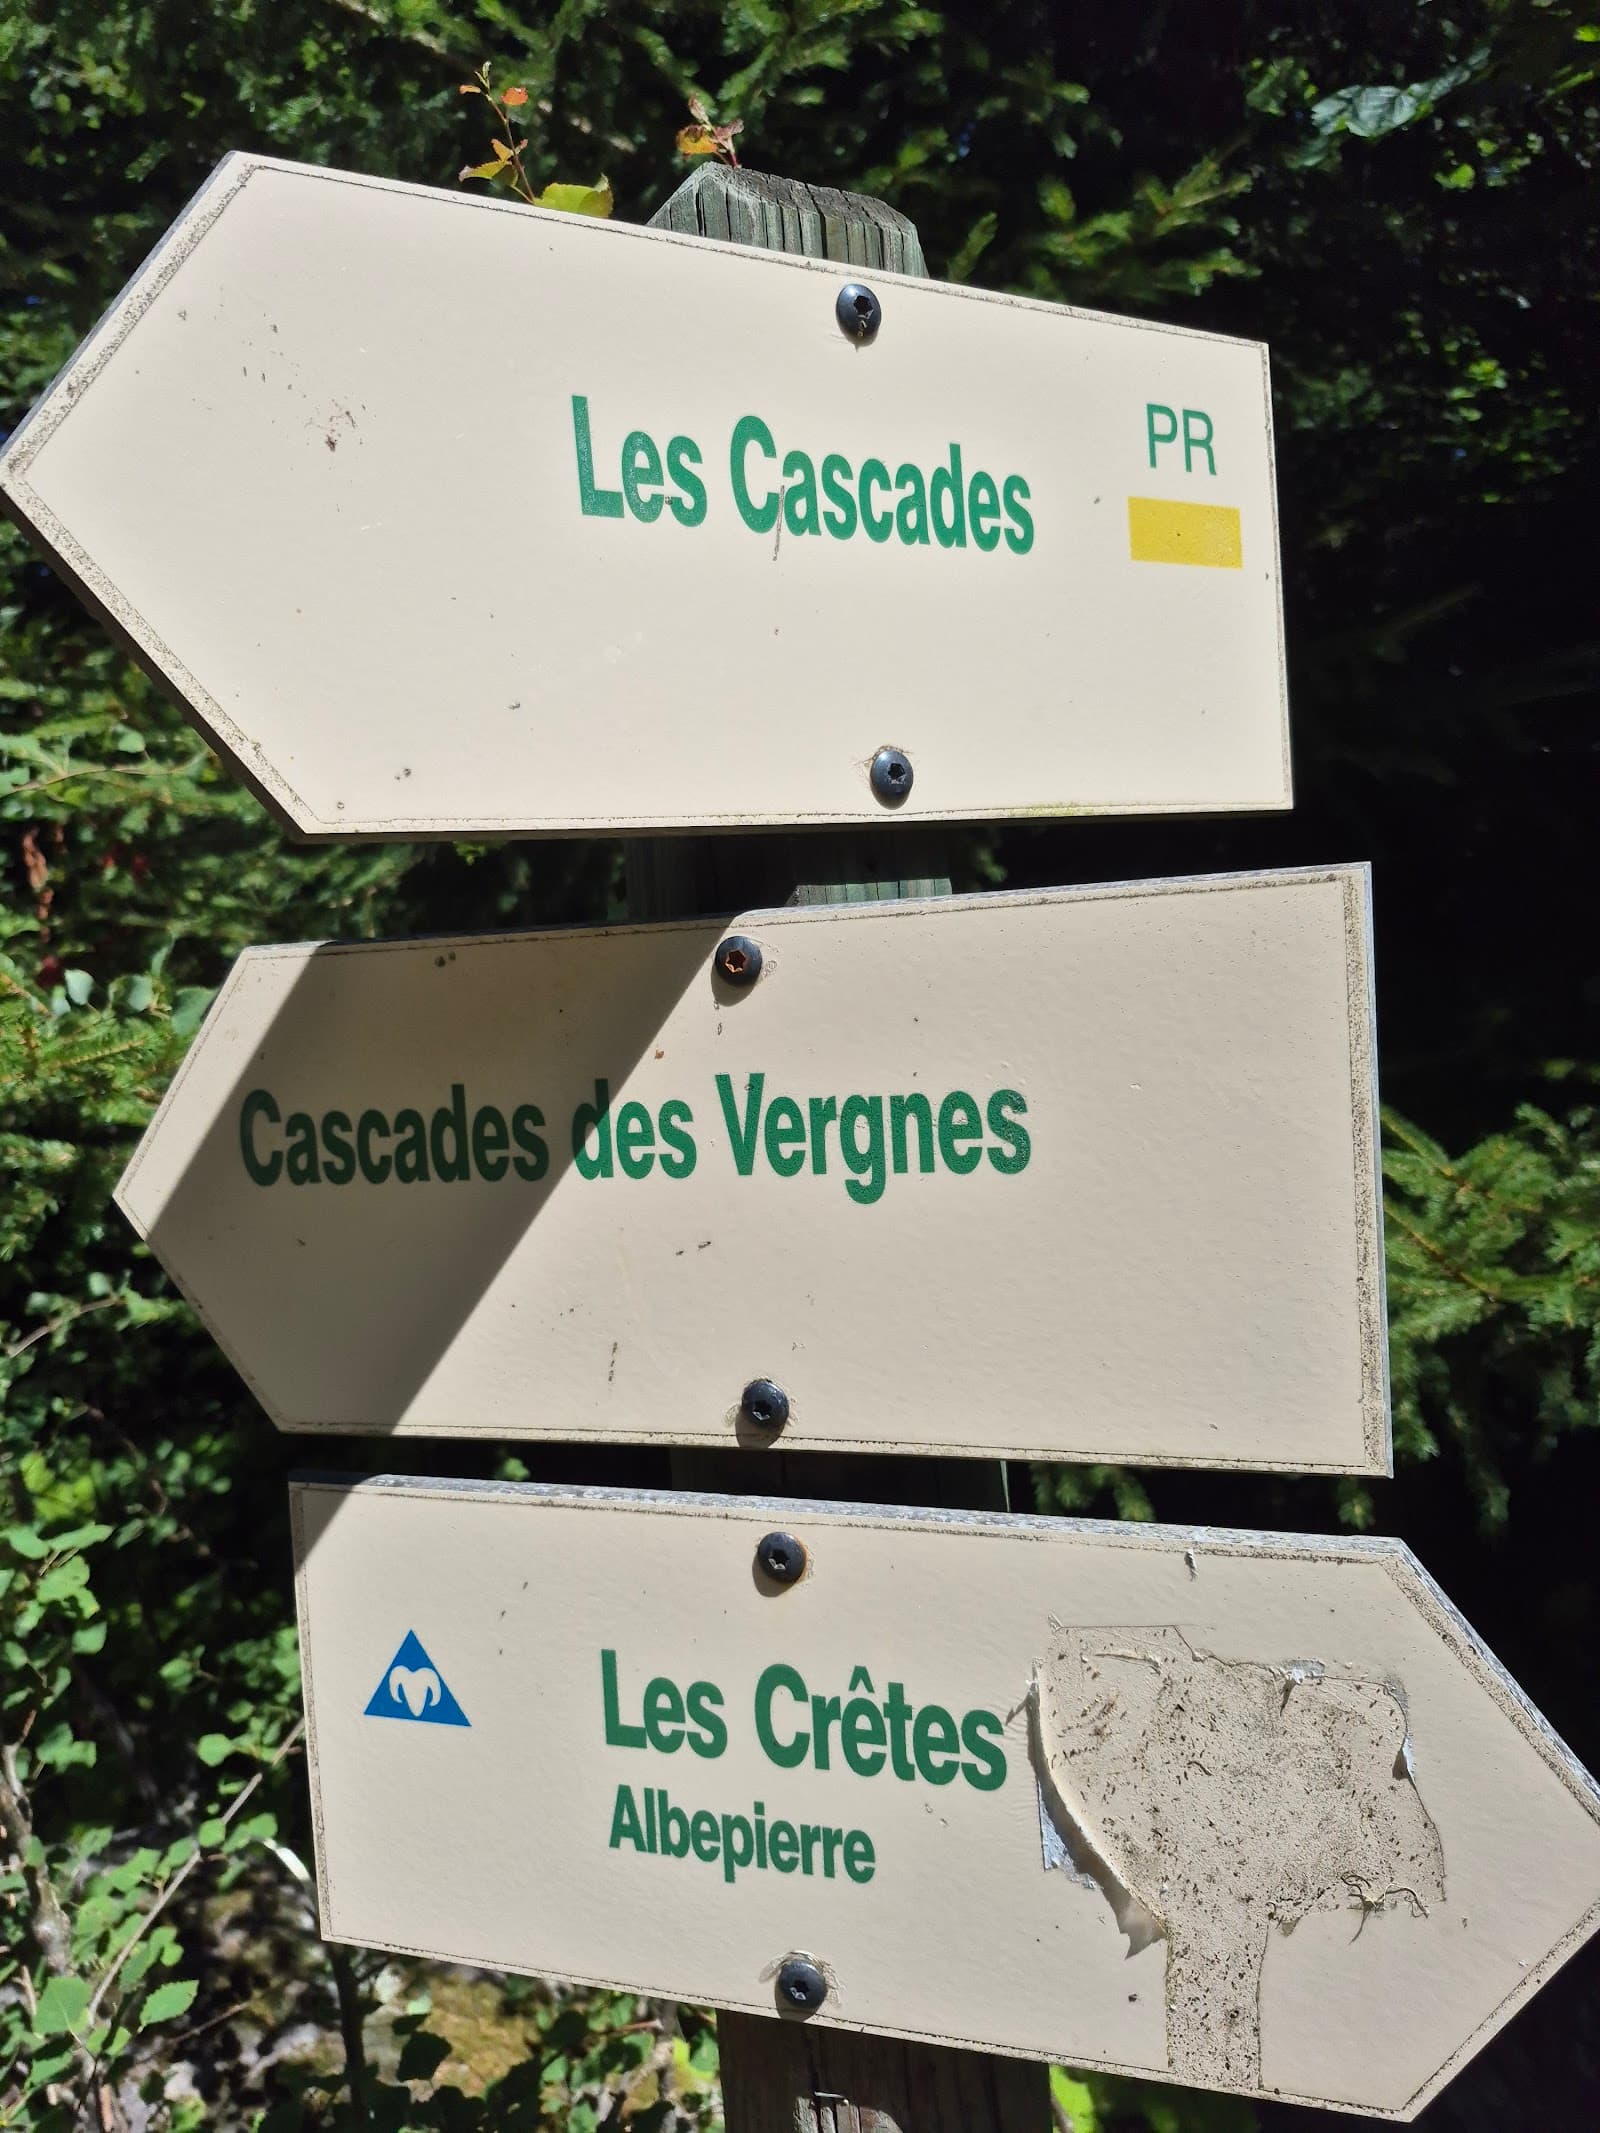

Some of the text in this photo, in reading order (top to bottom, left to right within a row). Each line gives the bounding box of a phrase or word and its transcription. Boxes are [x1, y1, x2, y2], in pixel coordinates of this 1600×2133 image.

[573, 396, 1034, 553] Les Cascades
[1147, 404, 1216, 474] PR
[240, 1073, 1031, 1204] Cascades des Vergnes
[601, 1649, 1006, 1790] Les Crêtes
[610, 1785, 875, 1882] Albepierre
